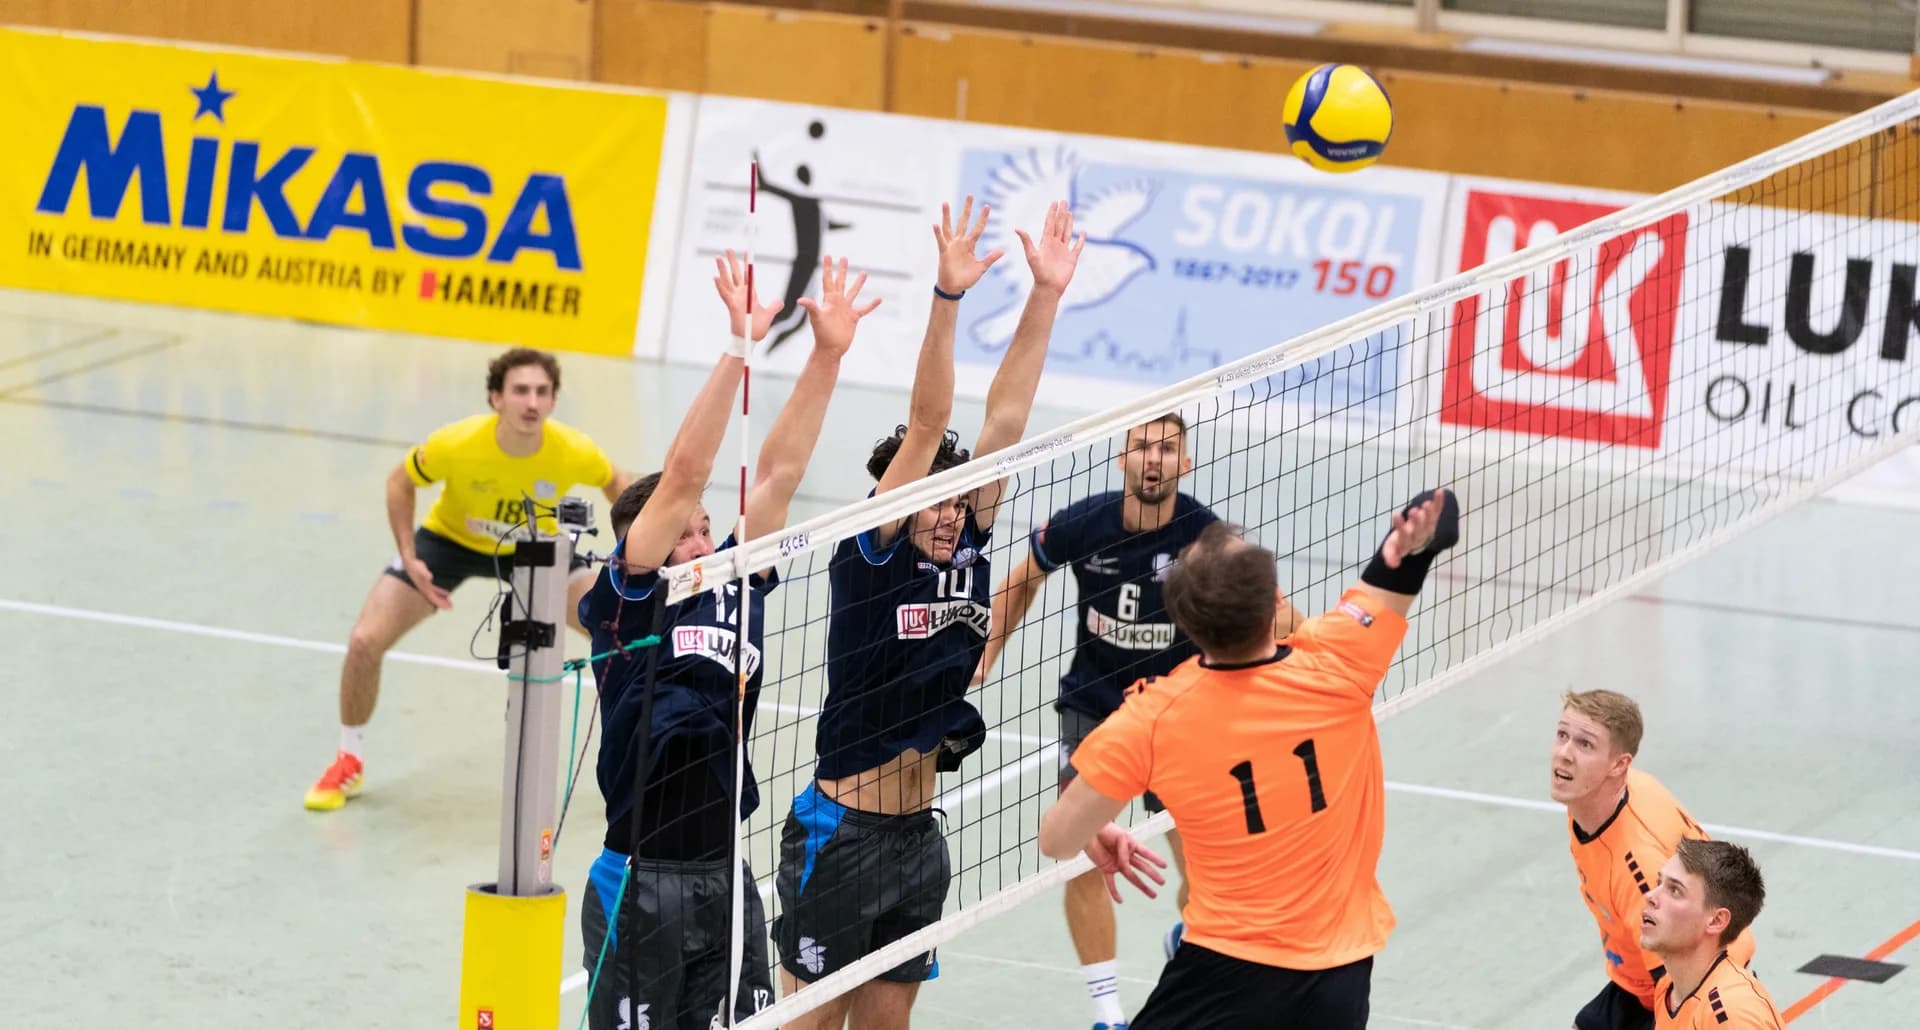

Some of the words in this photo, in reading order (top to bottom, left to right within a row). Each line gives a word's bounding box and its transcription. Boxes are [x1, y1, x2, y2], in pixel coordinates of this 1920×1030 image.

[35, 103, 583, 272] MIKASA
[1173, 185, 1402, 267] SOKOL
[28, 231, 53, 259] IN
[63, 235, 185, 273] GERMANY
[194, 247, 248, 280] AND
[257, 252, 364, 290] AUSTRIA
[371, 264, 405, 297] BY
[419, 270, 583, 318] HAMMER
[1312, 258, 1396, 299] 150
[1706, 375, 1805, 430] OIL
[495, 498, 524, 526] 18
[791, 531, 810, 549] CEV
[1117, 583, 1141, 622] 6
[1107, 623, 1170, 644] LUKOIL
[1229, 738, 1328, 834] 11
